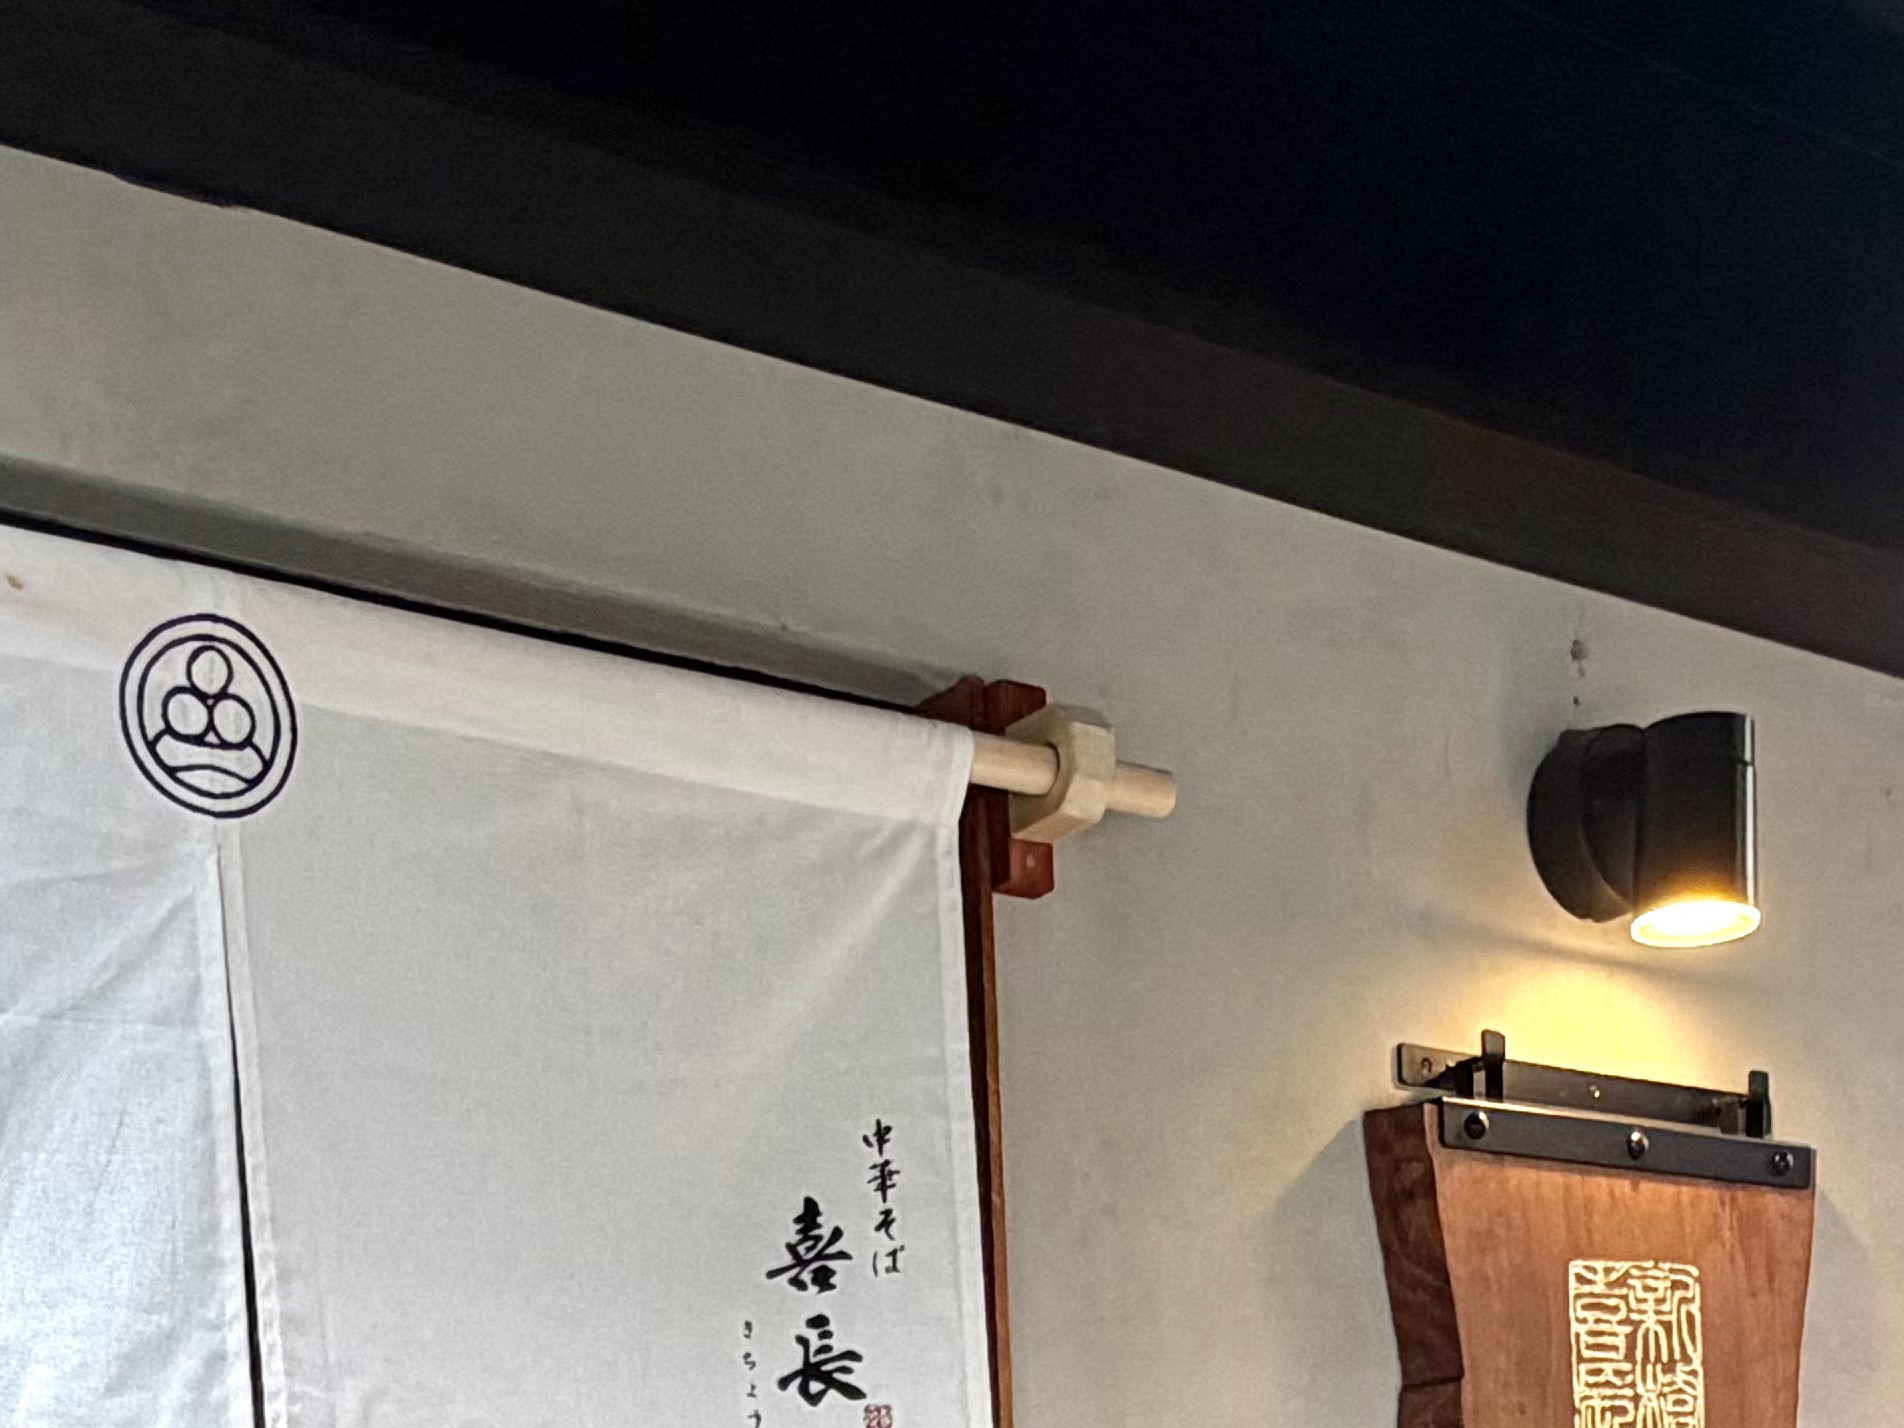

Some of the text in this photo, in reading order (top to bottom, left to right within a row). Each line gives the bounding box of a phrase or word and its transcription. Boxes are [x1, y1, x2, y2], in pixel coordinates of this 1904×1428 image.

[861, 1118, 905, 1278] 中華そば
[766, 1196, 867, 1406] 喜長
